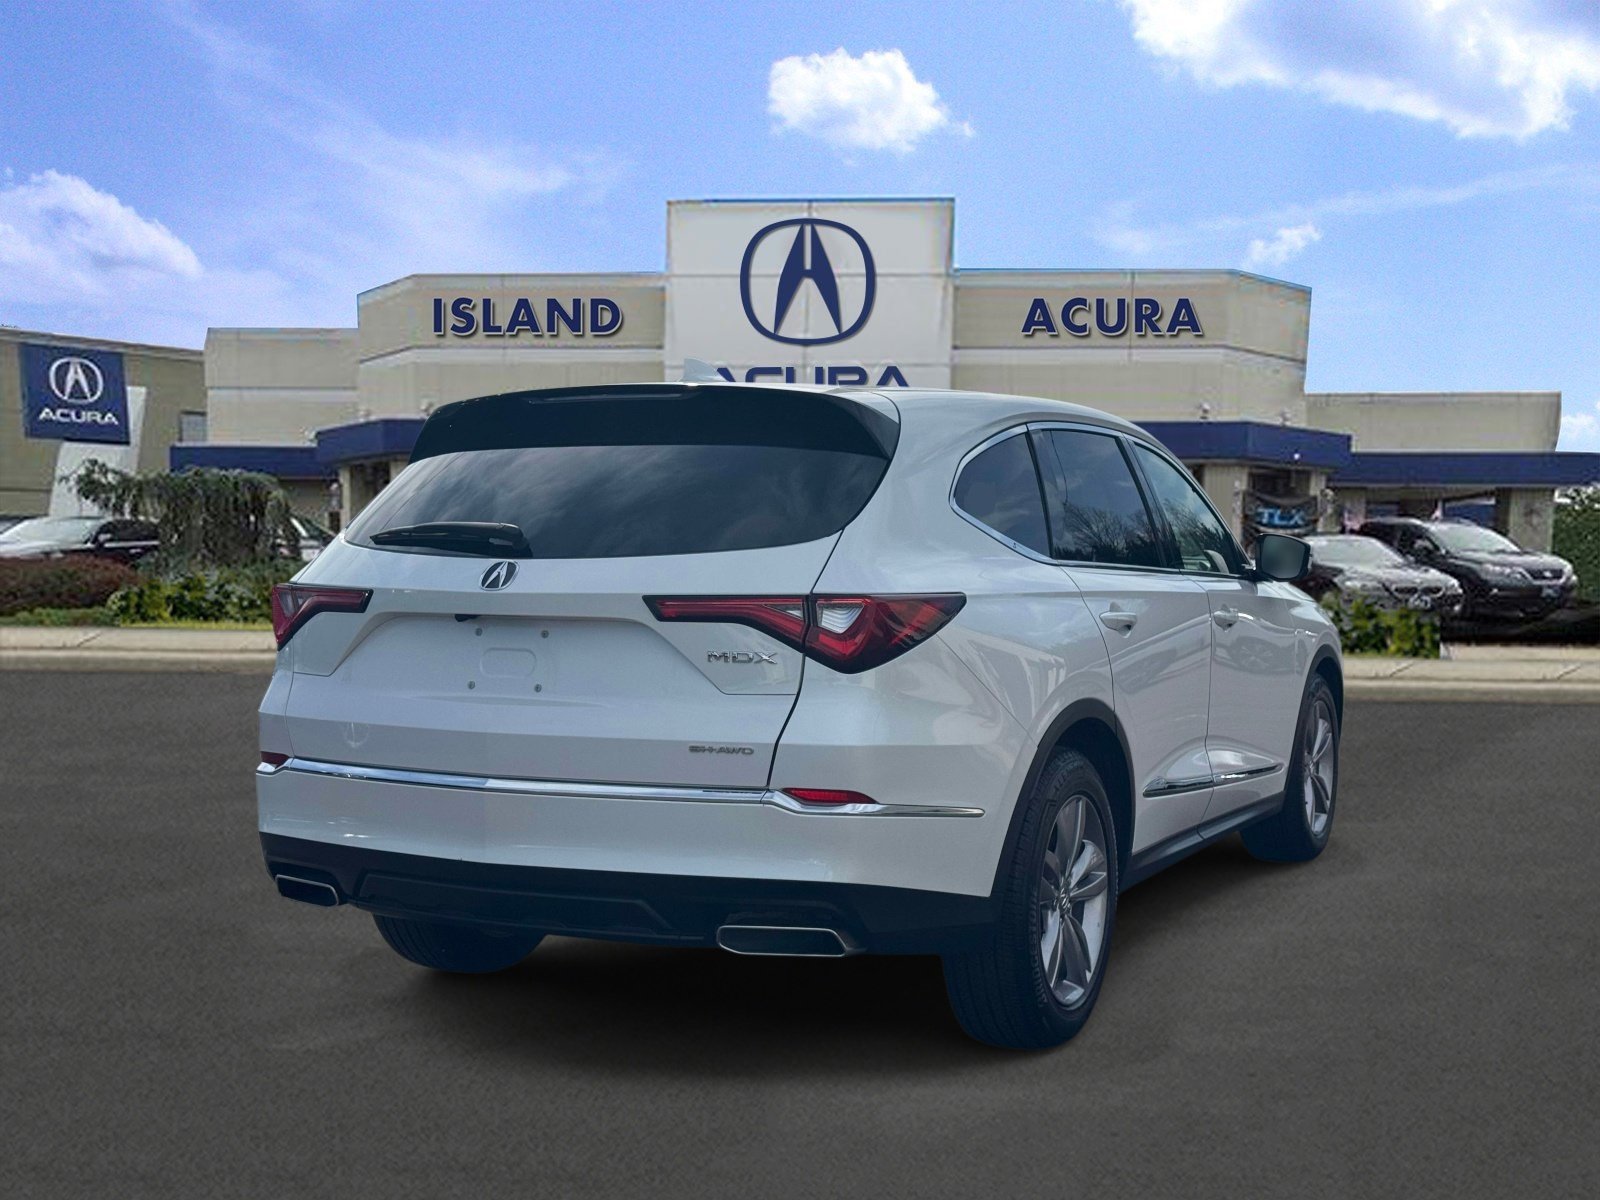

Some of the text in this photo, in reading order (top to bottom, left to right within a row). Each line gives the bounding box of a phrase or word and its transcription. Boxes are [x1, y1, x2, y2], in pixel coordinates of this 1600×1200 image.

[433, 297, 622, 335] ISLAND
[1021, 297, 1203, 336] ACURA
[716, 366, 909, 387] CURA
[39, 407, 118, 425] ACURA
[1257, 506, 1304, 525] TLX
[707, 651, 777, 664] MDX
[688, 745, 754, 755] SH-AWD
